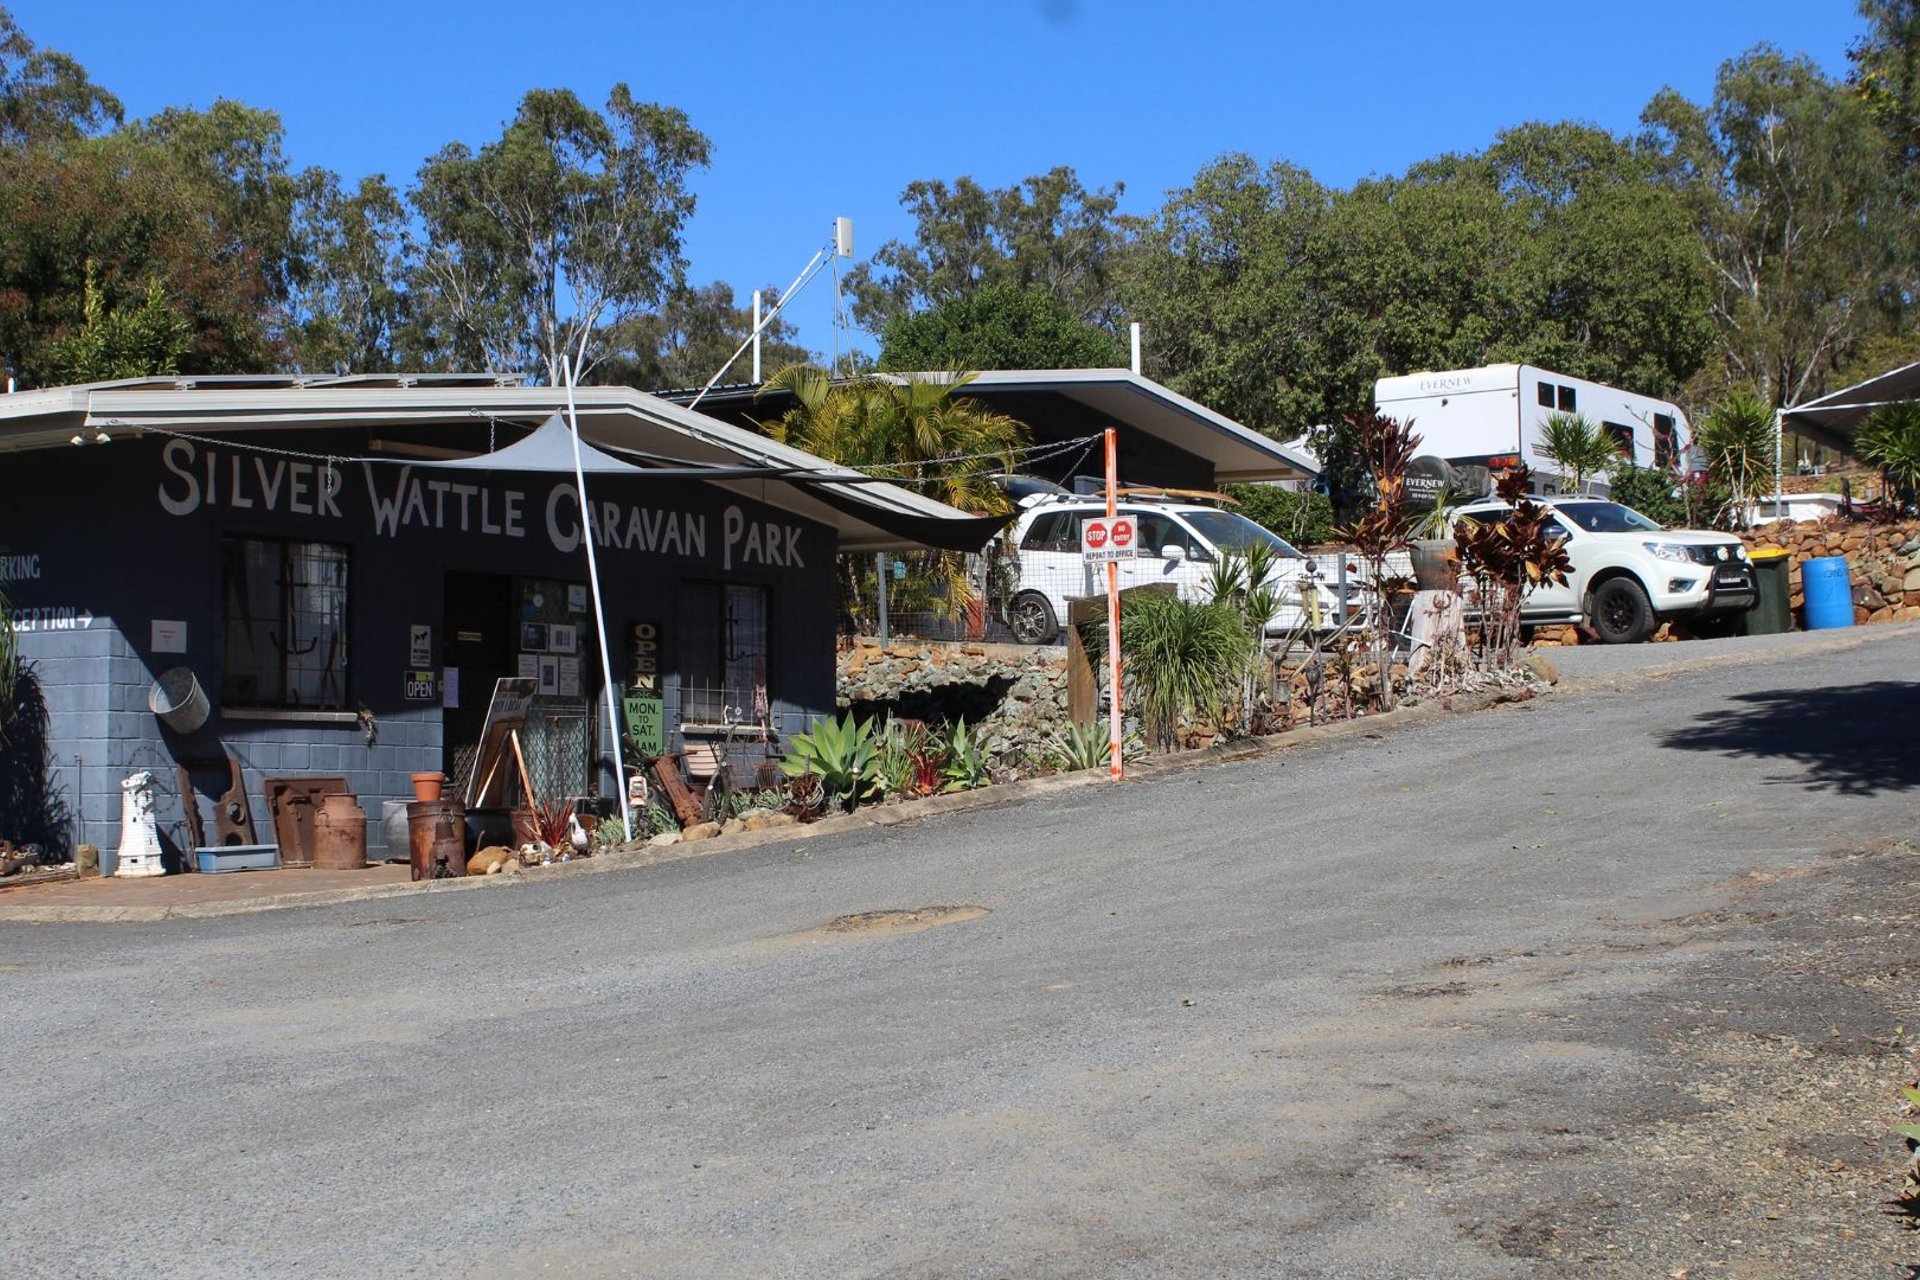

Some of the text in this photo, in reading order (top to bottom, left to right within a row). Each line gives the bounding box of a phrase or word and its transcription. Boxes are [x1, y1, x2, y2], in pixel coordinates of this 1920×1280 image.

[1420, 376, 1471, 390] EVERNEW
[1405, 477, 1445, 489] EVERNEW
[158, 438, 805, 571] SILVER WATTLE CARAVAN PARK
[1088, 531, 1106, 541] STOP
[634, 623, 656, 688] OPEN
[407, 681, 433, 697] OPEN
[629, 702, 659, 715] MON.
[638, 715, 649, 724] TO
[632, 724, 655, 736] SAT.
